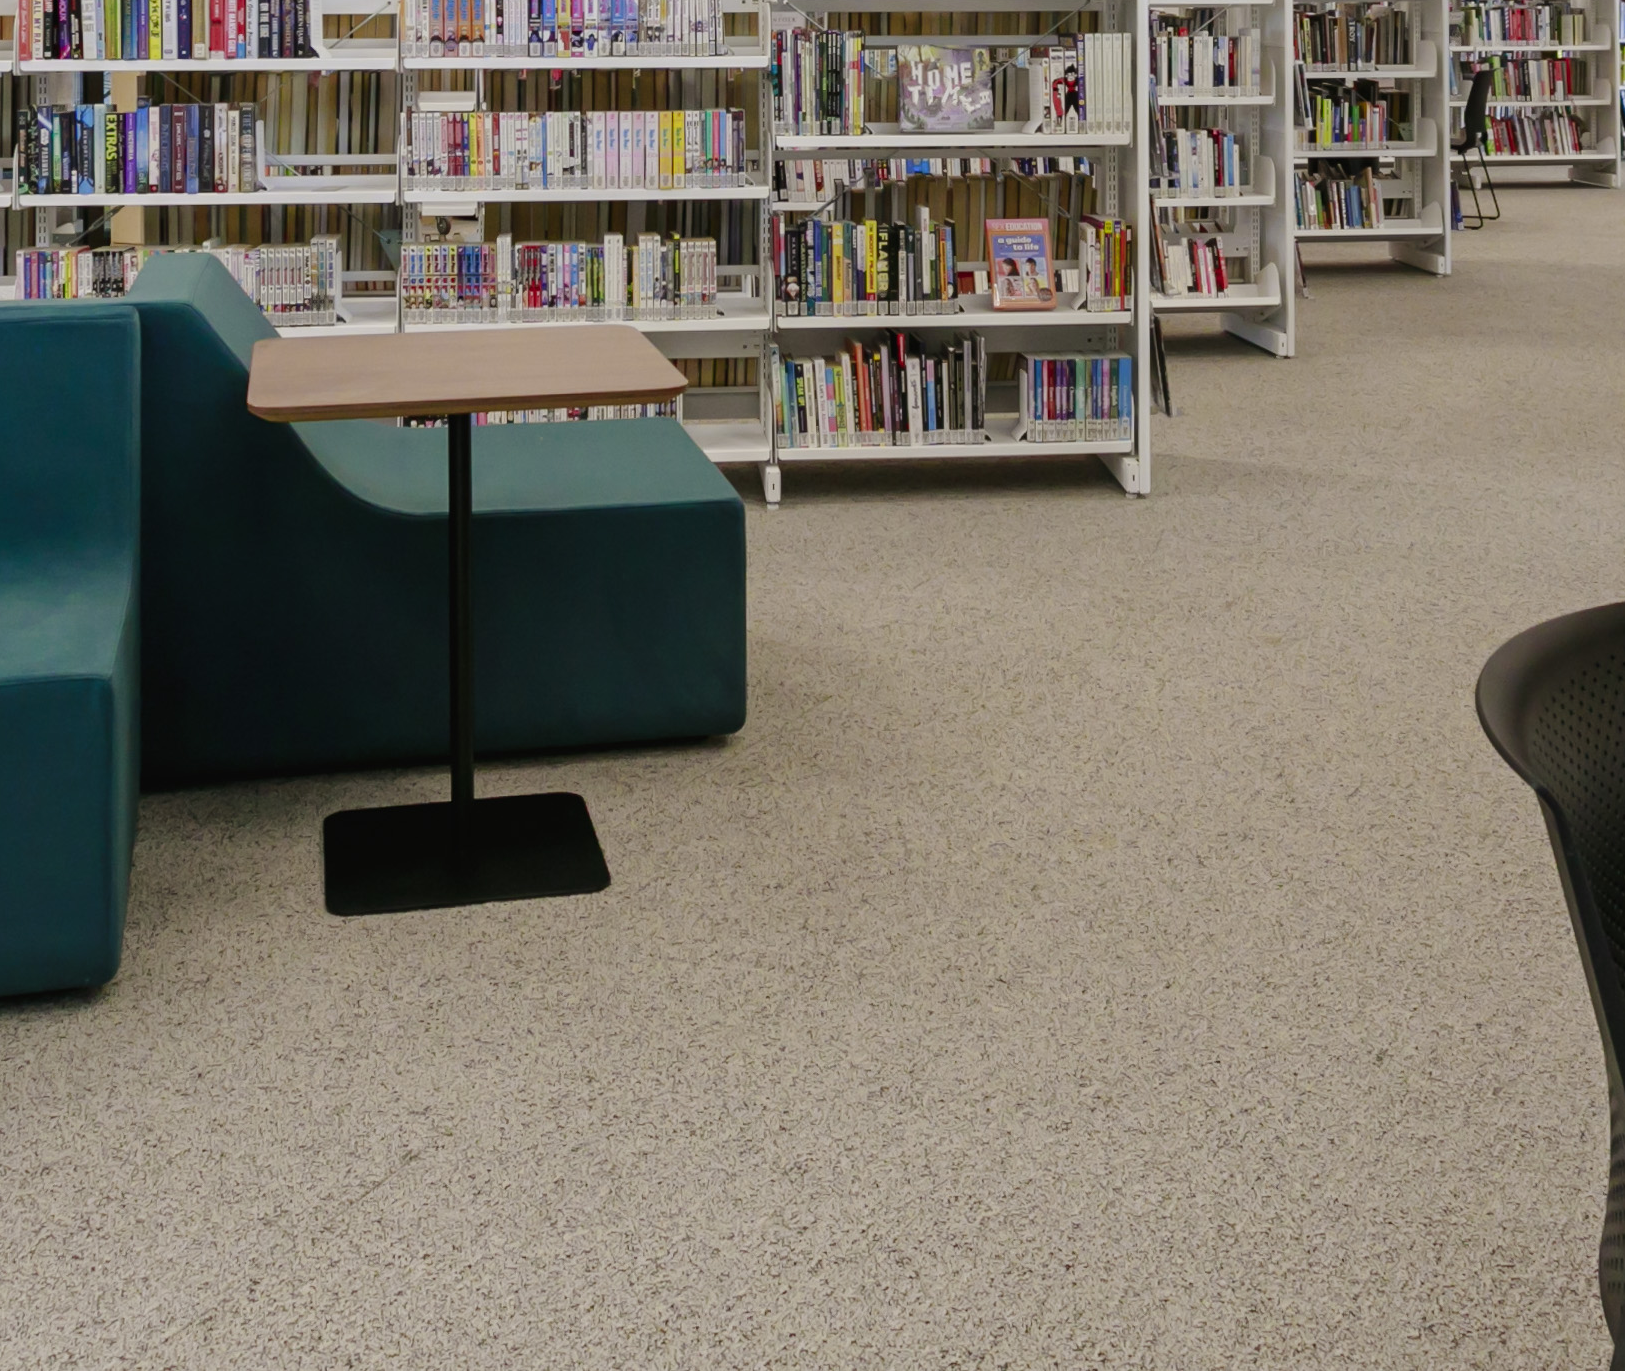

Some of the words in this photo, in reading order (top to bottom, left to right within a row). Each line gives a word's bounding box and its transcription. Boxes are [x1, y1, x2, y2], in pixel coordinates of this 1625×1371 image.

[34, 0, 42, 14] ALL
[34, 18, 42, 29] MY
[909, 61, 972, 88] HOME
[106, 115, 116, 160] EXTRAS
[1006, 223, 1042, 231] EDUCATION
[1006, 236, 1031, 244] guide
[877, 233, 888, 290] FLAMER
